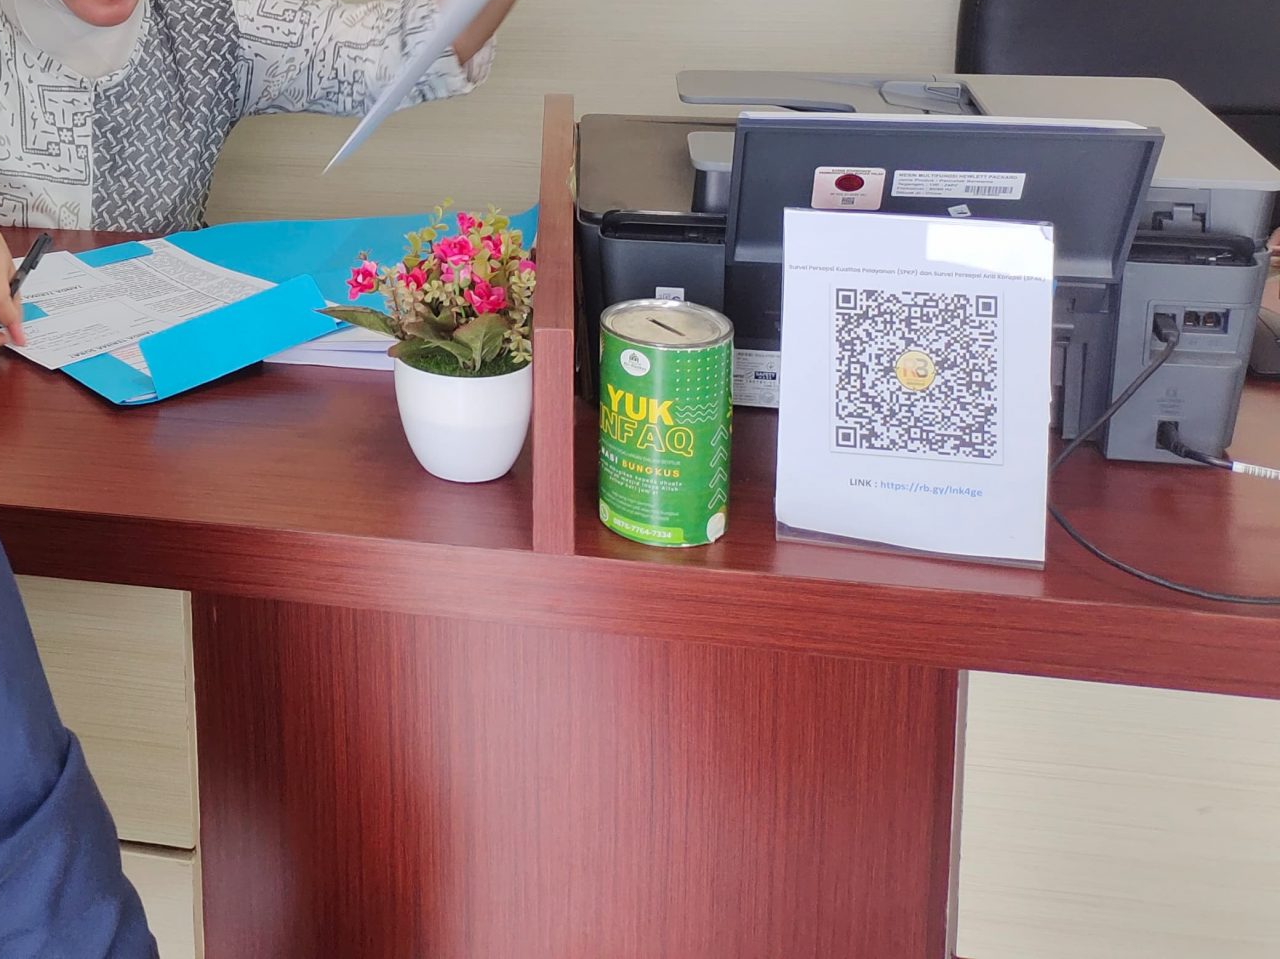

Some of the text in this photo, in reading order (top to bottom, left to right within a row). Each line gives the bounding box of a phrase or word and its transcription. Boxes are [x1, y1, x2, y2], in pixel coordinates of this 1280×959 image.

[607, 383, 674, 426] YUK
[622, 459, 680, 478] BUNGKUS
[849, 478, 872, 488] LINK
